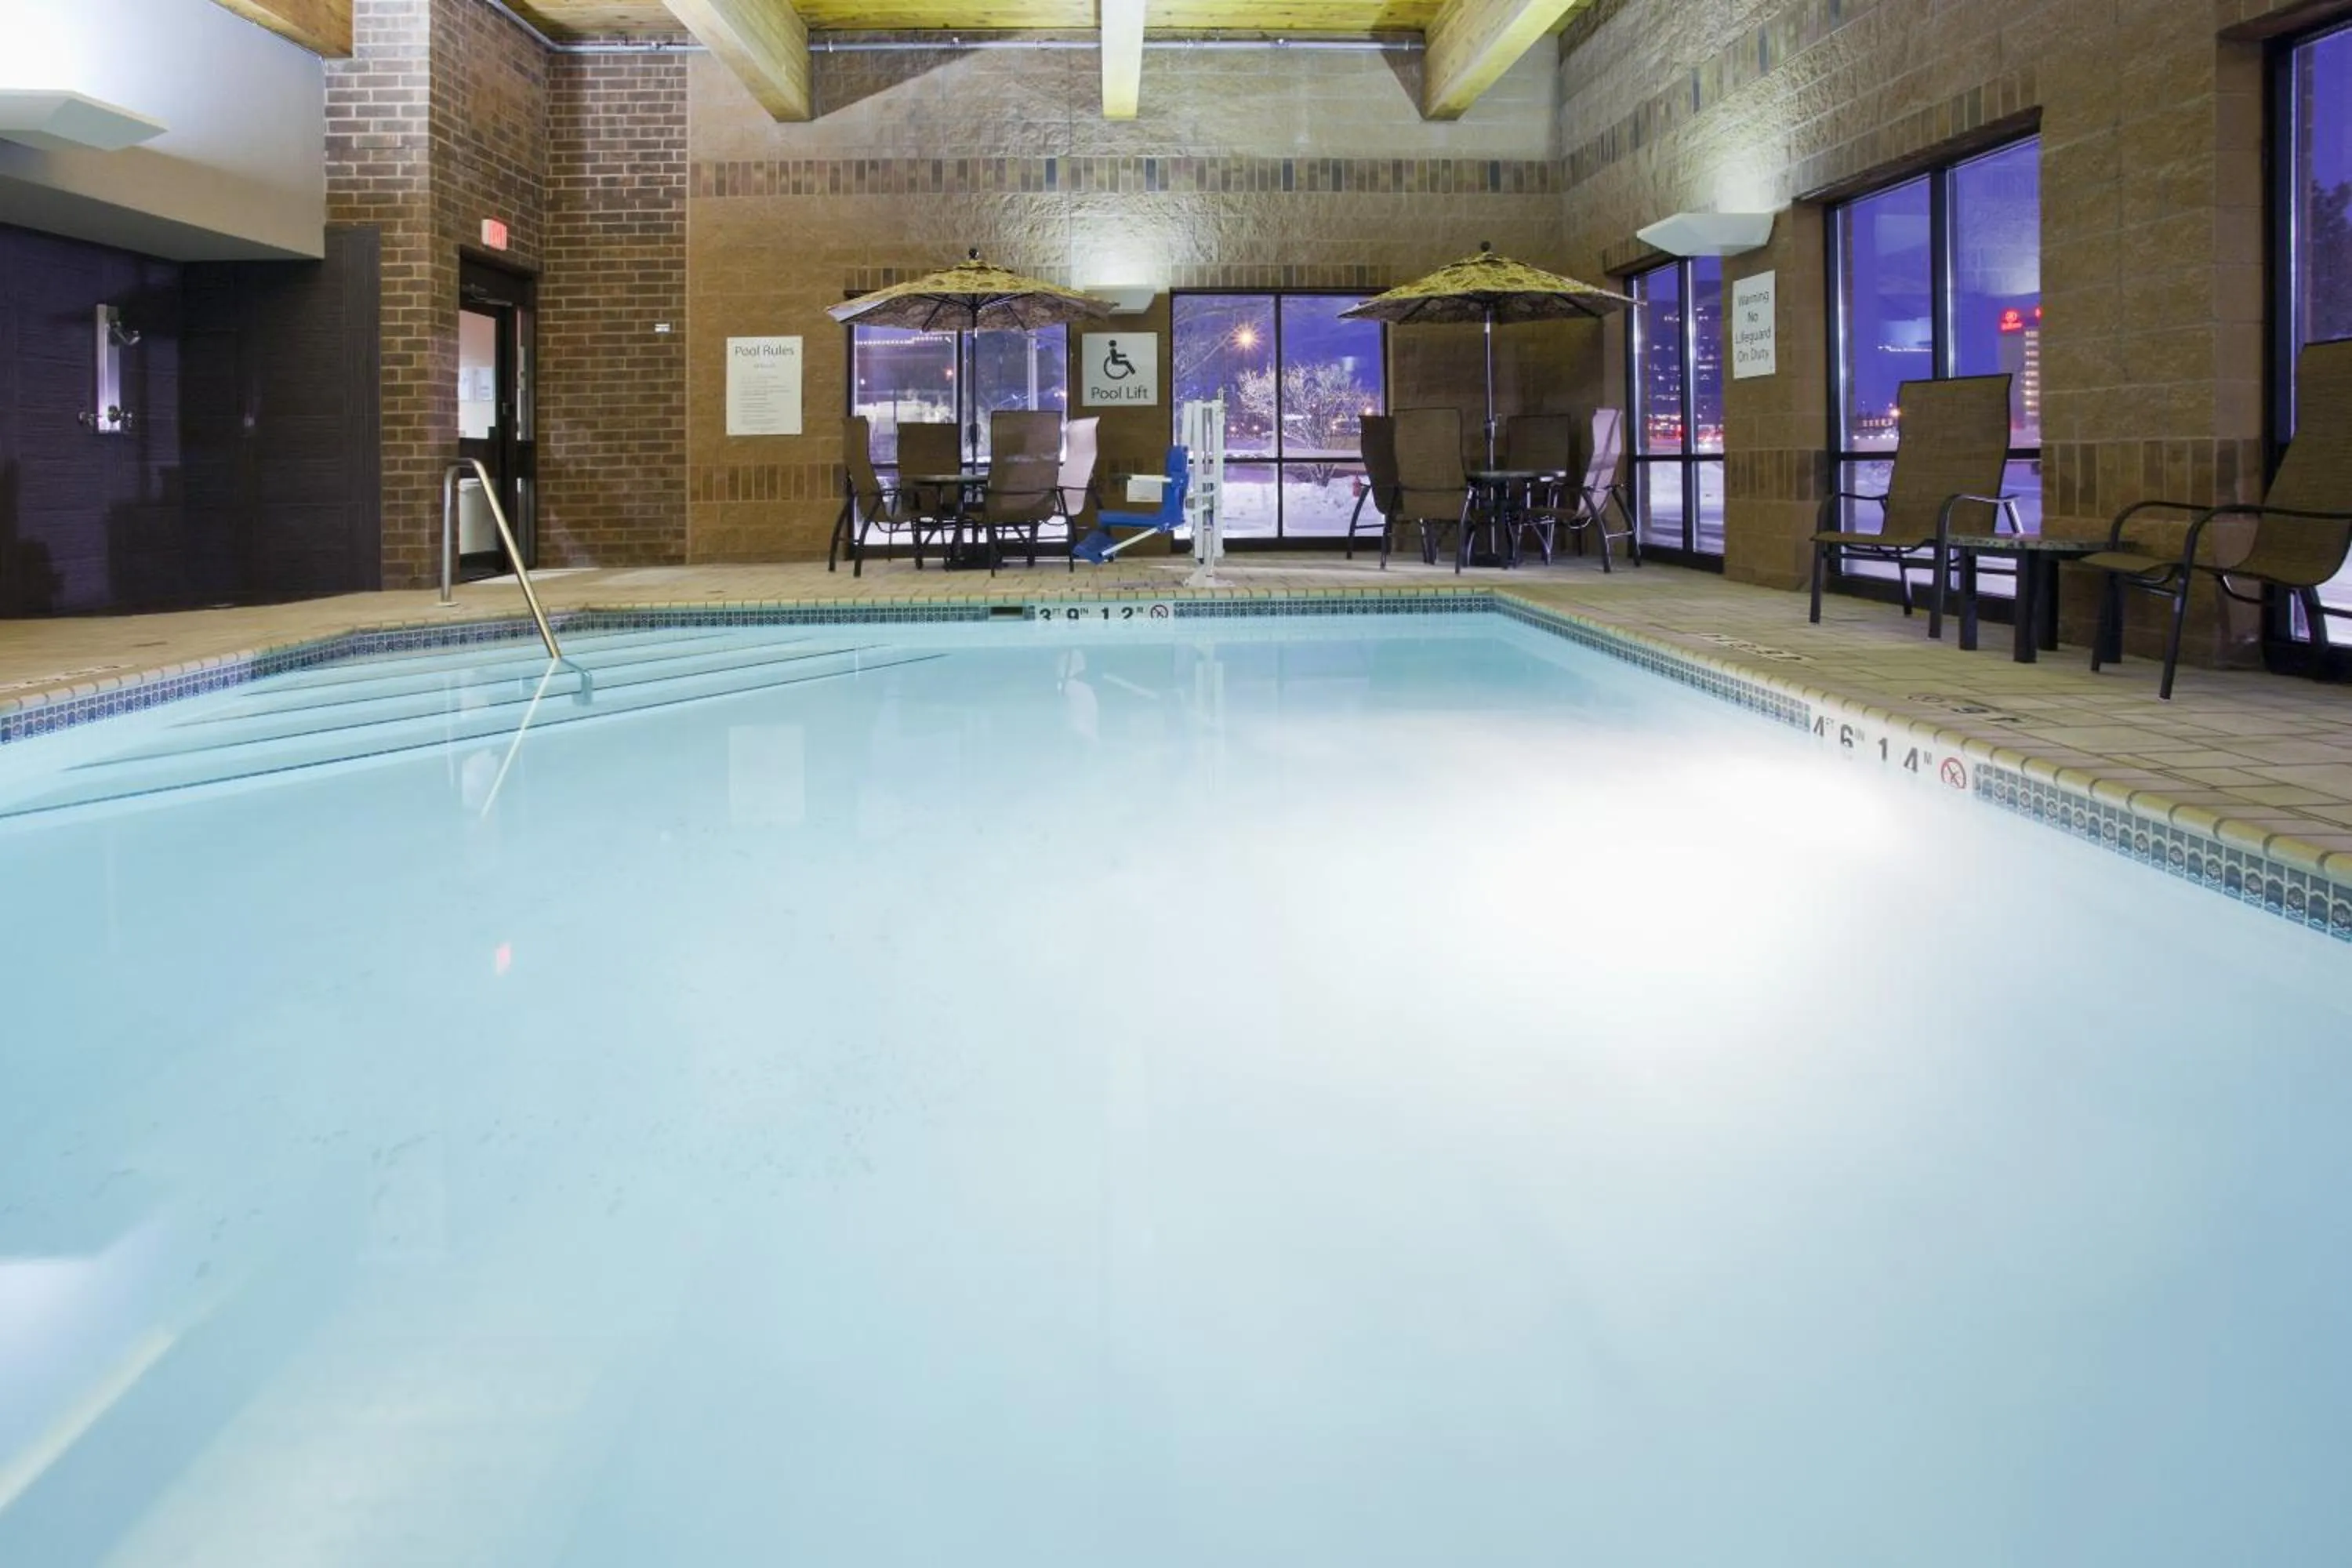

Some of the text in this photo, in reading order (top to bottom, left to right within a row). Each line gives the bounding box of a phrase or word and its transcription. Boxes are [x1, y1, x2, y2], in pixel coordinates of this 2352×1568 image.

[1738, 291, 1769, 307] Warning
[1747, 311, 1759, 322] No
[1735, 326, 1771, 345] Lifeguard
[735, 344, 794, 356] Pool Rules
[1737, 348, 1770, 362] On Duty
[1091, 386, 1148, 400] Pool Lift
